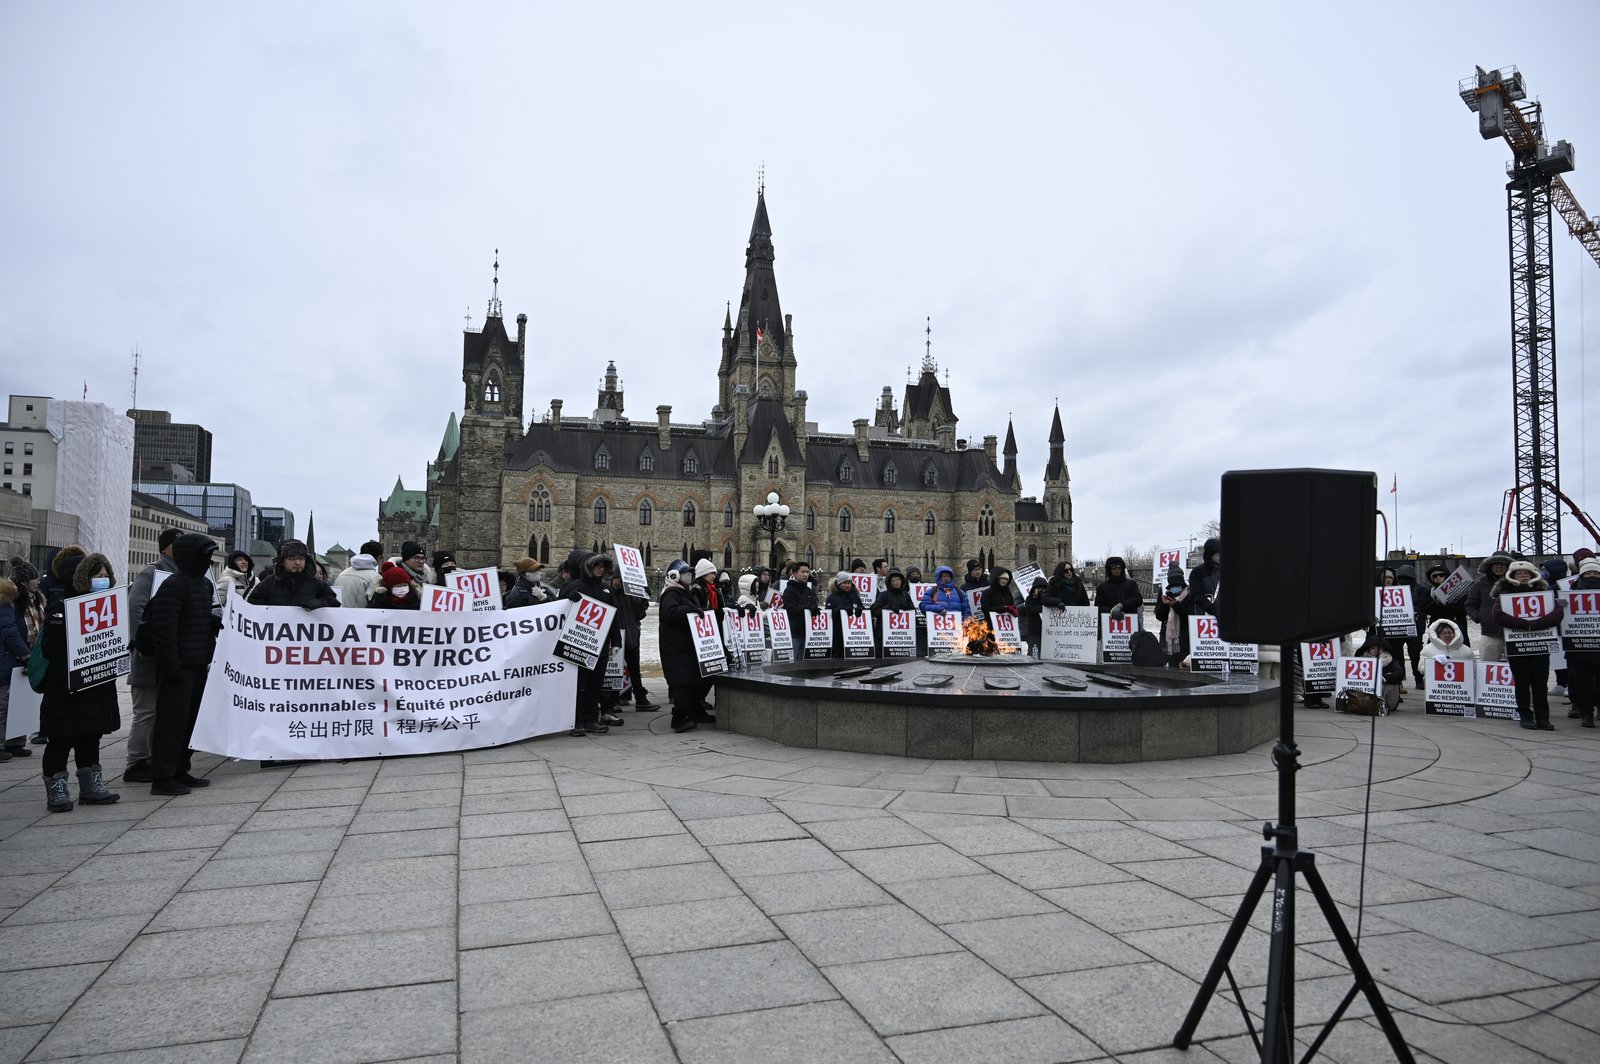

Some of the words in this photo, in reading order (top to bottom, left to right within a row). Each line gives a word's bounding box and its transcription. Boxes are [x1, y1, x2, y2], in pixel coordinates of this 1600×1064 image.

[622, 549, 637, 566] 39
[1162, 552, 1177, 566] 37
[461, 574, 486, 597] 90
[854, 577, 868, 591] 16
[1443, 575, 1460, 592] 28
[435, 591, 460, 611] 40
[1383, 590, 1402, 606] 36
[1517, 597, 1540, 617] 19
[1575, 594, 1599, 614] 11
[85, 596, 114, 632] 54
[580, 602, 602, 629] 42
[773, 613, 784, 630] 36
[813, 613, 826, 630] 38
[849, 614, 864, 629] 24
[892, 613, 907, 629] 34
[936, 615, 952, 630] 35
[998, 616, 1012, 630] 16
[237, 612, 335, 642] DEMAND
[341, 624, 360, 642] A
[366, 625, 457, 645] TIMELY
[568, 629, 588, 640] WAITING
[575, 624, 596, 636] MONTHS
[698, 615, 712, 638] 34
[1112, 620, 1128, 633] 11
[1200, 619, 1218, 638] 25
[78, 642, 107, 655] WAITING
[109, 637, 122, 646] FOR
[85, 630, 114, 644] MONTHS
[563, 634, 574, 642] IRCC
[574, 639, 599, 652] RESPONSE
[74, 656, 89, 666] IRCC
[91, 644, 125, 661] RESPONSE
[265, 646, 385, 665] DELAYED
[393, 649, 428, 667] BY
[434, 647, 492, 666] IRCC
[1312, 643, 1331, 660] 23
[94, 668, 117, 680] RESULTS
[394, 670, 501, 690] PROCEDURAL
[504, 662, 565, 680] FAIRNESS
[1348, 661, 1369, 679] 28
[1444, 662, 1455, 681] 8
[1490, 666, 1513, 685] 19
[284, 678, 375, 690] TIMELINES
[233, 694, 265, 712] Délais
[270, 700, 376, 712] raisonnables
[396, 696, 445, 713] Équité
[450, 687, 532, 710] procédurale
[288, 719, 374, 739] 给出时限
[397, 713, 480, 734] 程序公平
